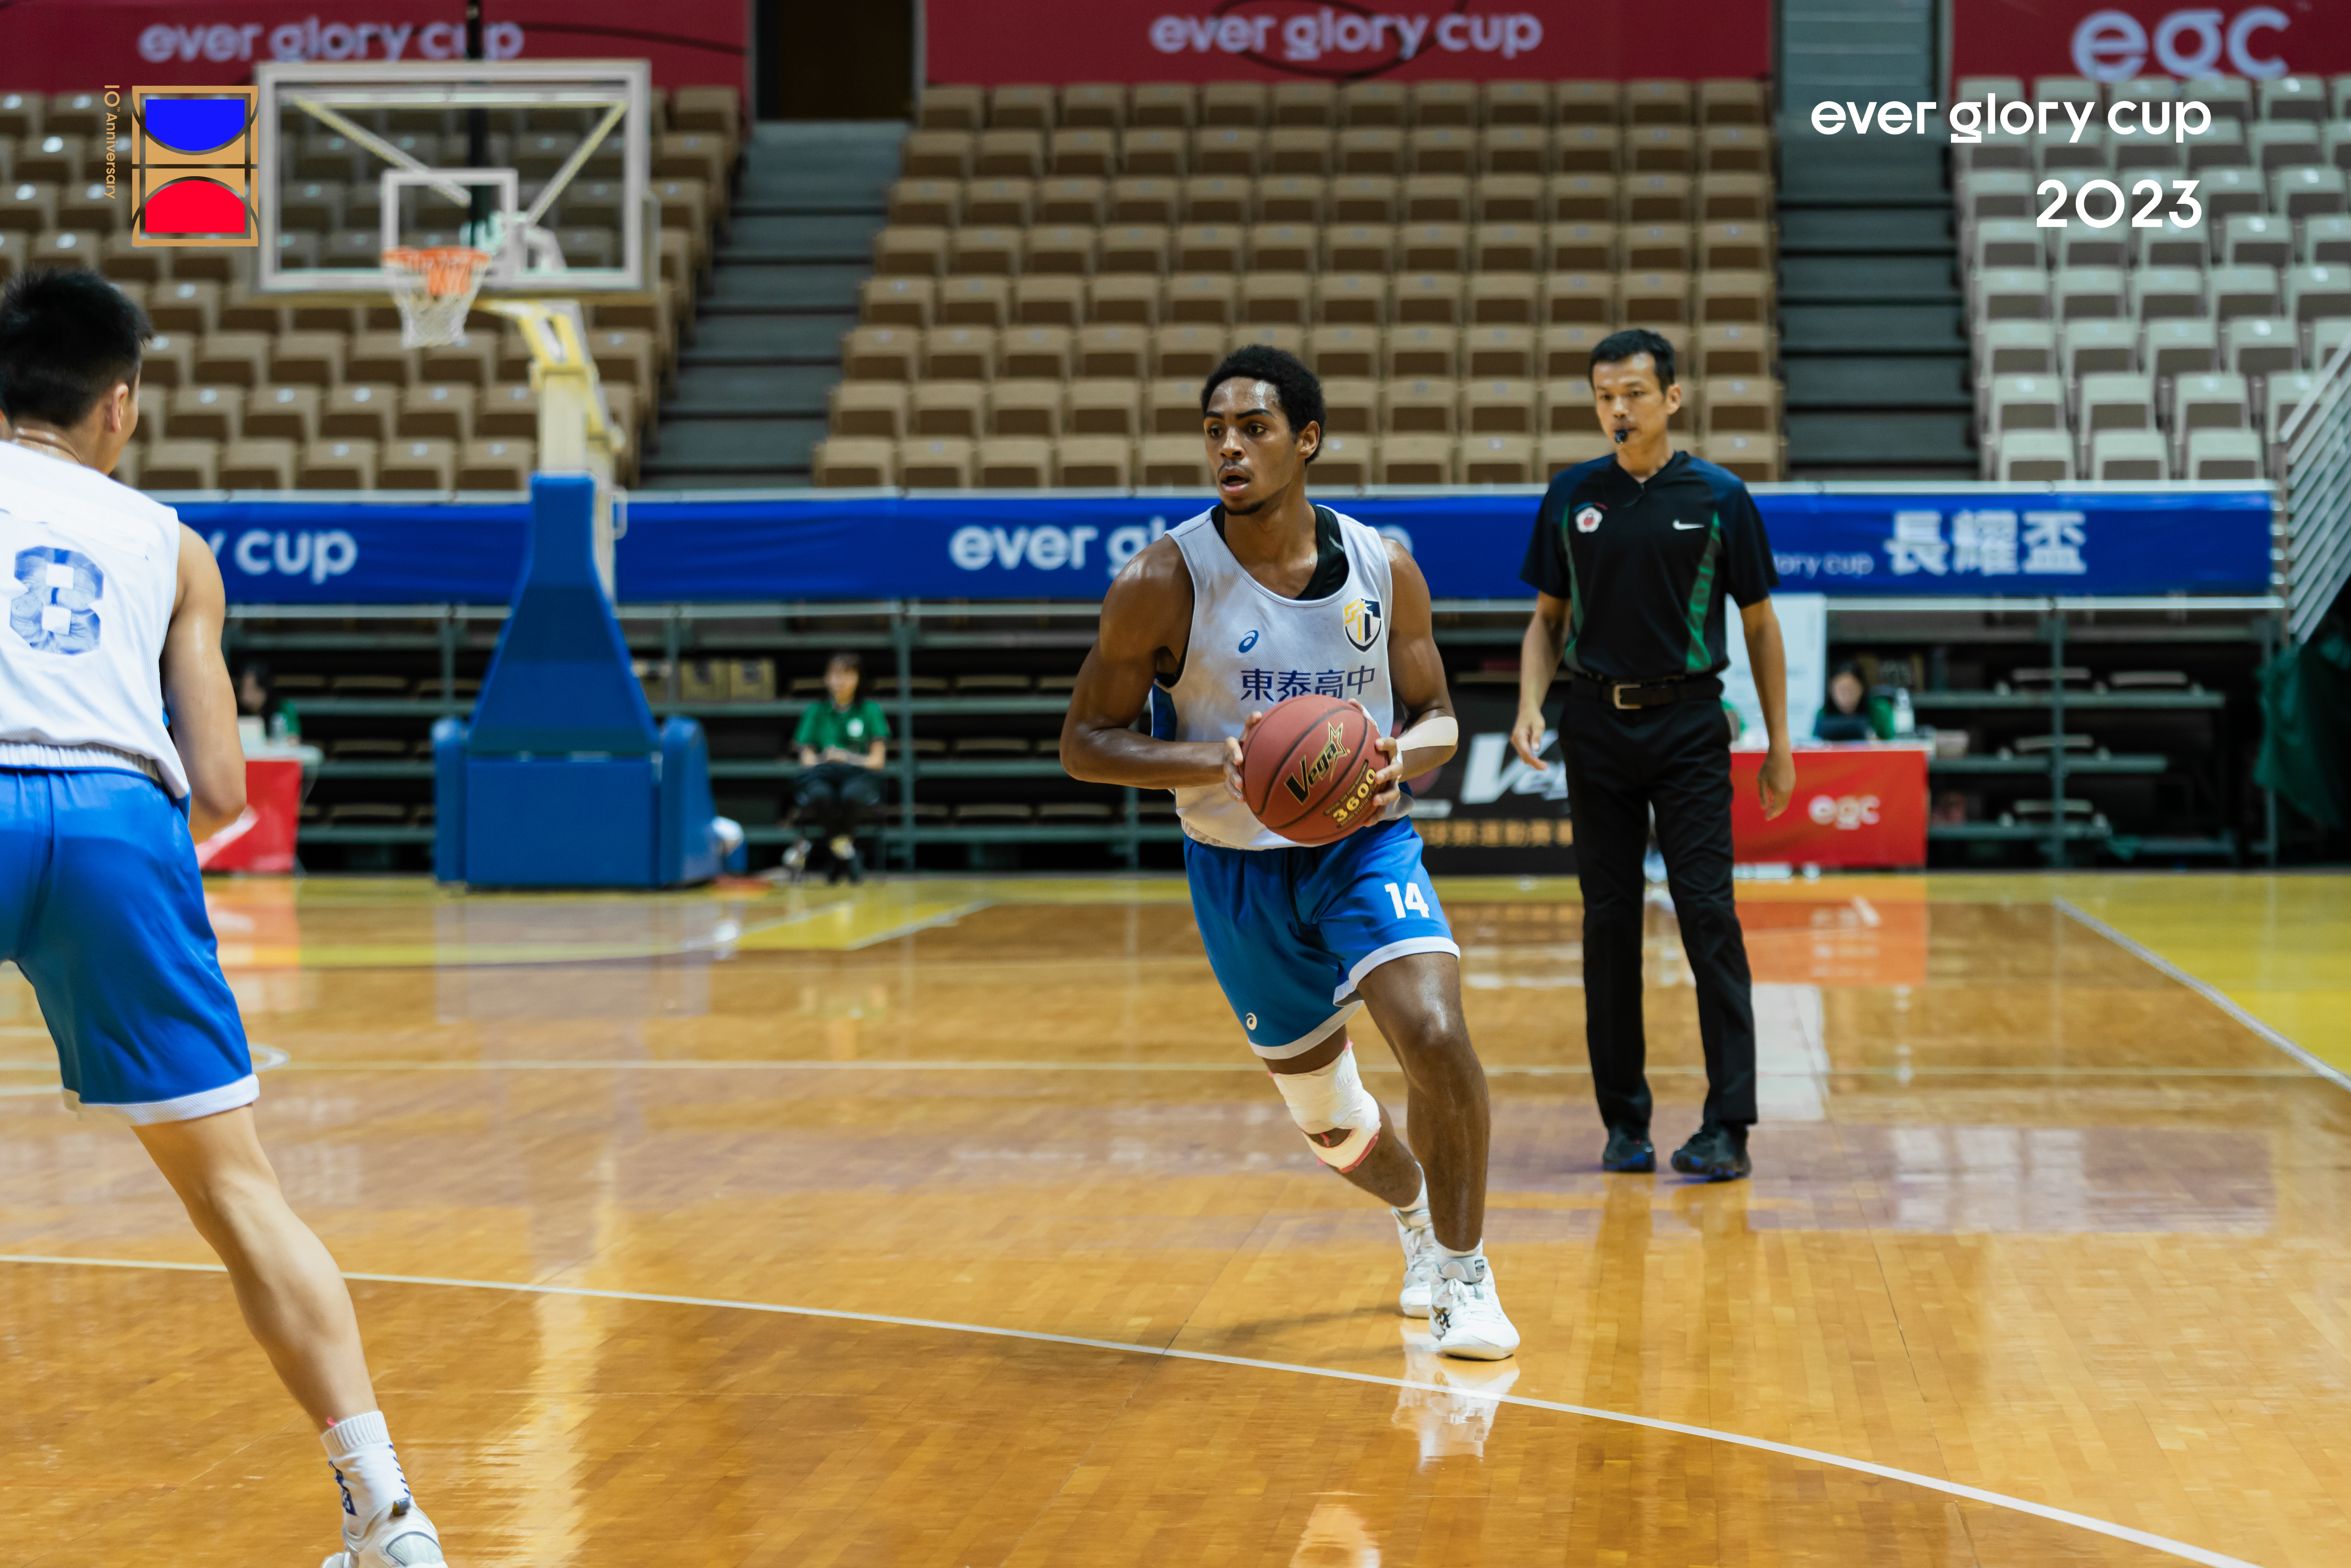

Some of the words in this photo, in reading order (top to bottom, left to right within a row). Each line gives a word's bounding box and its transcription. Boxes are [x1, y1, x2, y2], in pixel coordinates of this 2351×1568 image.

[138, 23, 263, 62] ever
[269, 16, 413, 62] glory
[1150, 14, 1276, 53] ever
[1283, 7, 1429, 61] glory
[1436, 13, 1542, 59] cup
[2070, 5, 2292, 84] egc
[235, 529, 359, 585] cup
[949, 524, 1099, 570] ever
[10, 545, 104, 656] 8
[1241, 665, 1375, 703] 東泰高中
[1283, 736, 1341, 806] Vega
[1332, 768, 1376, 823] 3600
[1808, 795, 1881, 830] egc
[1384, 882, 1430, 919] 14
